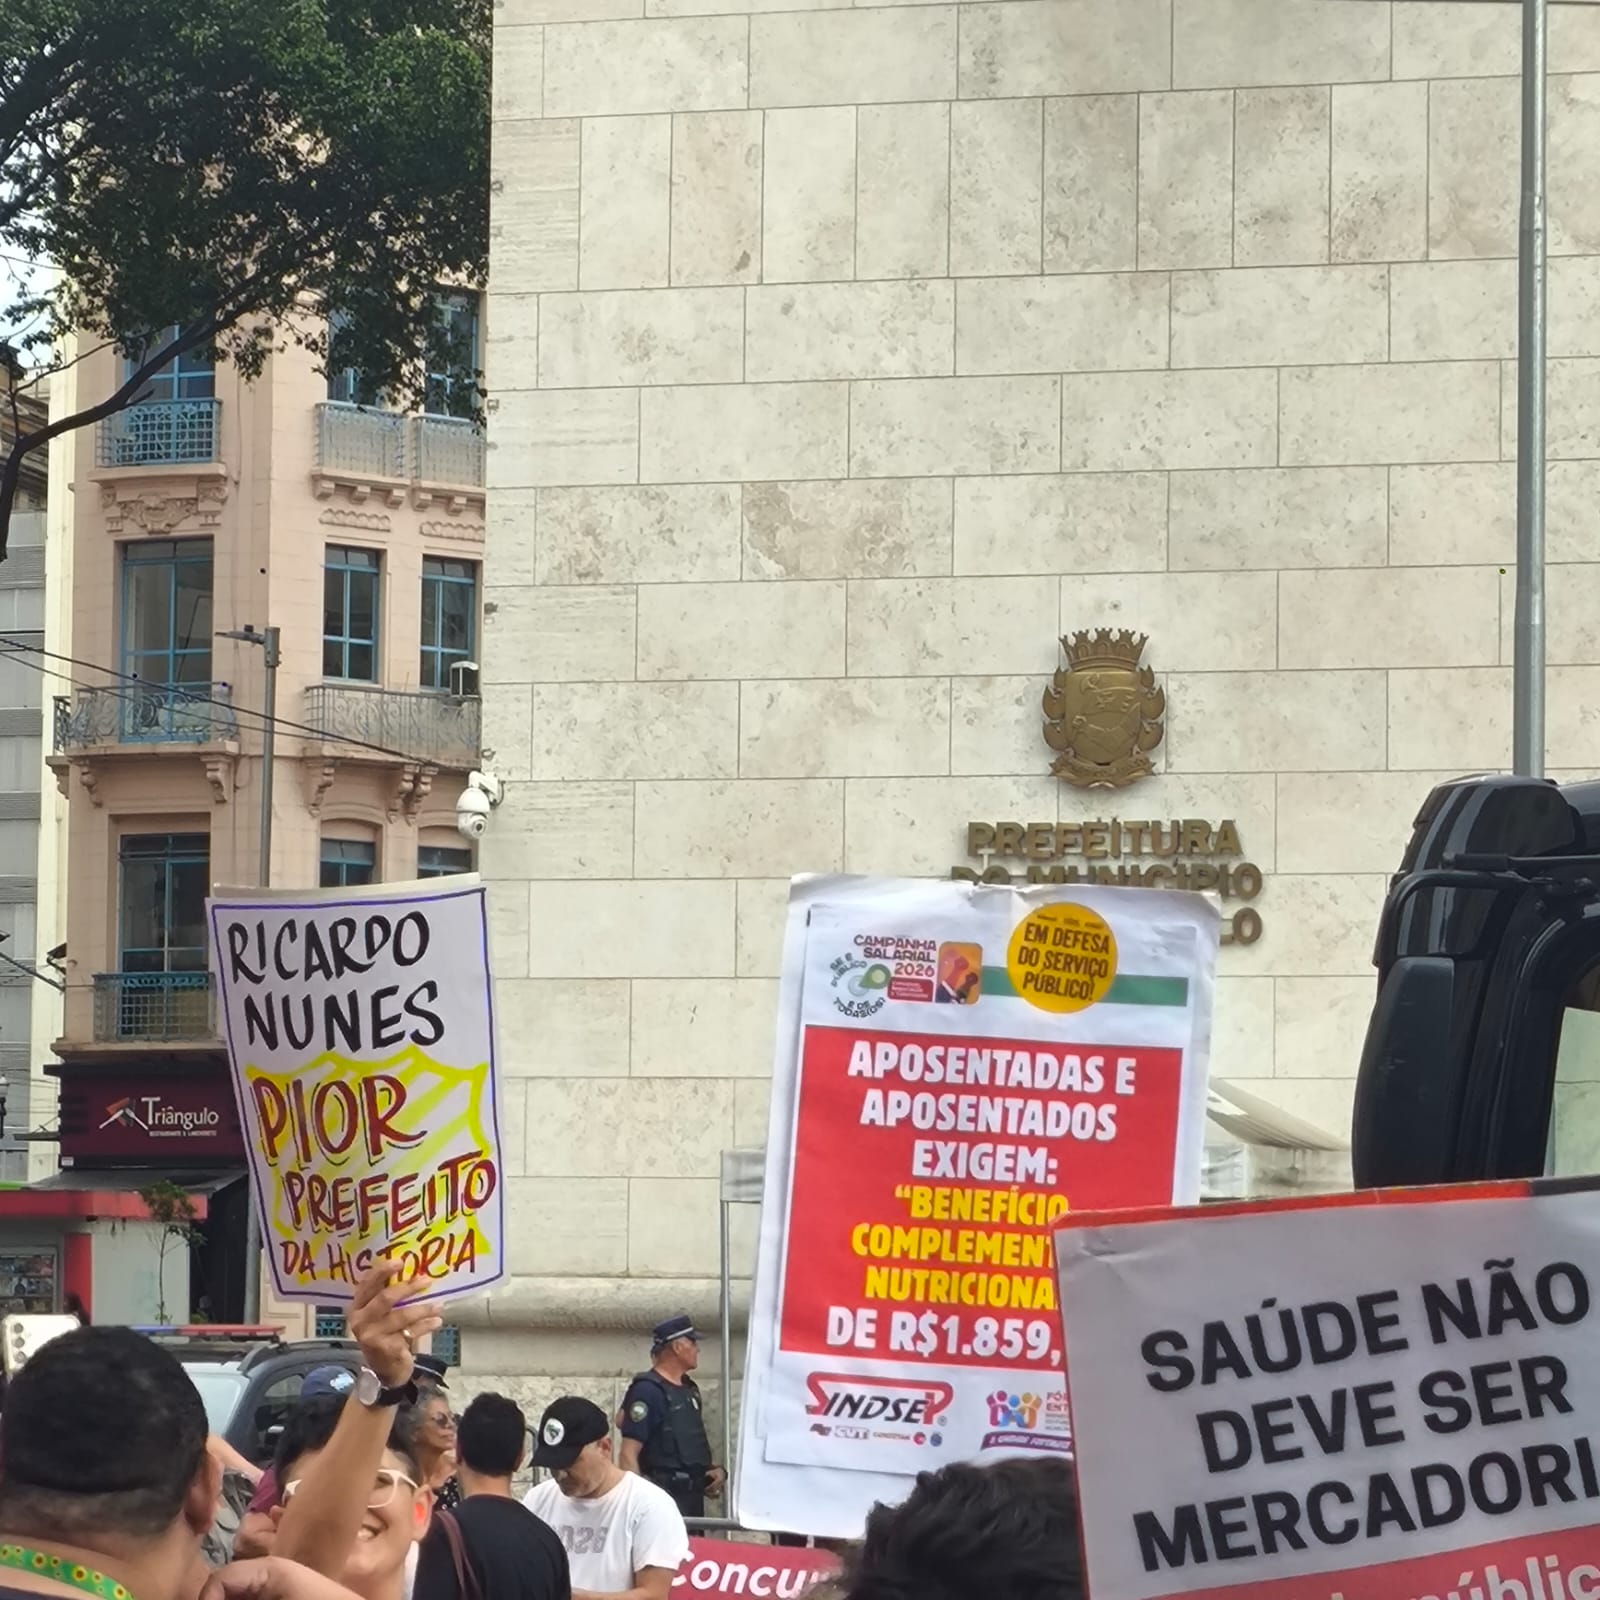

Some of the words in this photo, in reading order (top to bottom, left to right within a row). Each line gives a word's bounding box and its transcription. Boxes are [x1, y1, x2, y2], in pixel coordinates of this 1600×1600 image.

[967, 819, 1244, 859] PREFEITURA
[225, 911, 430, 984] RICARDO
[853, 934, 937, 951] CAMPANHA
[863, 947, 937, 963] SALARIAL
[1018, 946, 1040, 967] DO
[1043, 950, 1109, 978] SERVIÇO
[1024, 922, 1049, 944] EM
[1052, 927, 1109, 955] DEFESA
[893, 962, 936, 977] 2026
[244, 981, 445, 1052] NUNES
[848, 1040, 1104, 1094] APOSENTADAS
[1115, 1057, 1136, 1095] E
[141, 1097, 219, 1130] Triângulo
[248, 1074, 428, 1167] PIOR
[859, 1088, 1117, 1141] APOSENTADOS
[912, 1139, 1058, 1184] EXIGEM:
[280, 1150, 497, 1239] PREFEITO
[280, 1240, 316, 1280] DA
[865, 1265, 1058, 1310] NUTRICIONA
[826, 1305, 876, 1349] DE
[889, 1309, 1060, 1367] R$1.859,
[1140, 1290, 1409, 1392] SAÚDE
[1420, 1257, 1591, 1345] NÃO
[805, 1371, 953, 1424] SINDSEP
[1196, 1381, 1405, 1473] DEVE
[1418, 1355, 1575, 1434] SER
[1133, 1436, 1600, 1572] MERCADORI
[1410, 1554, 1600, 1600] úblic
